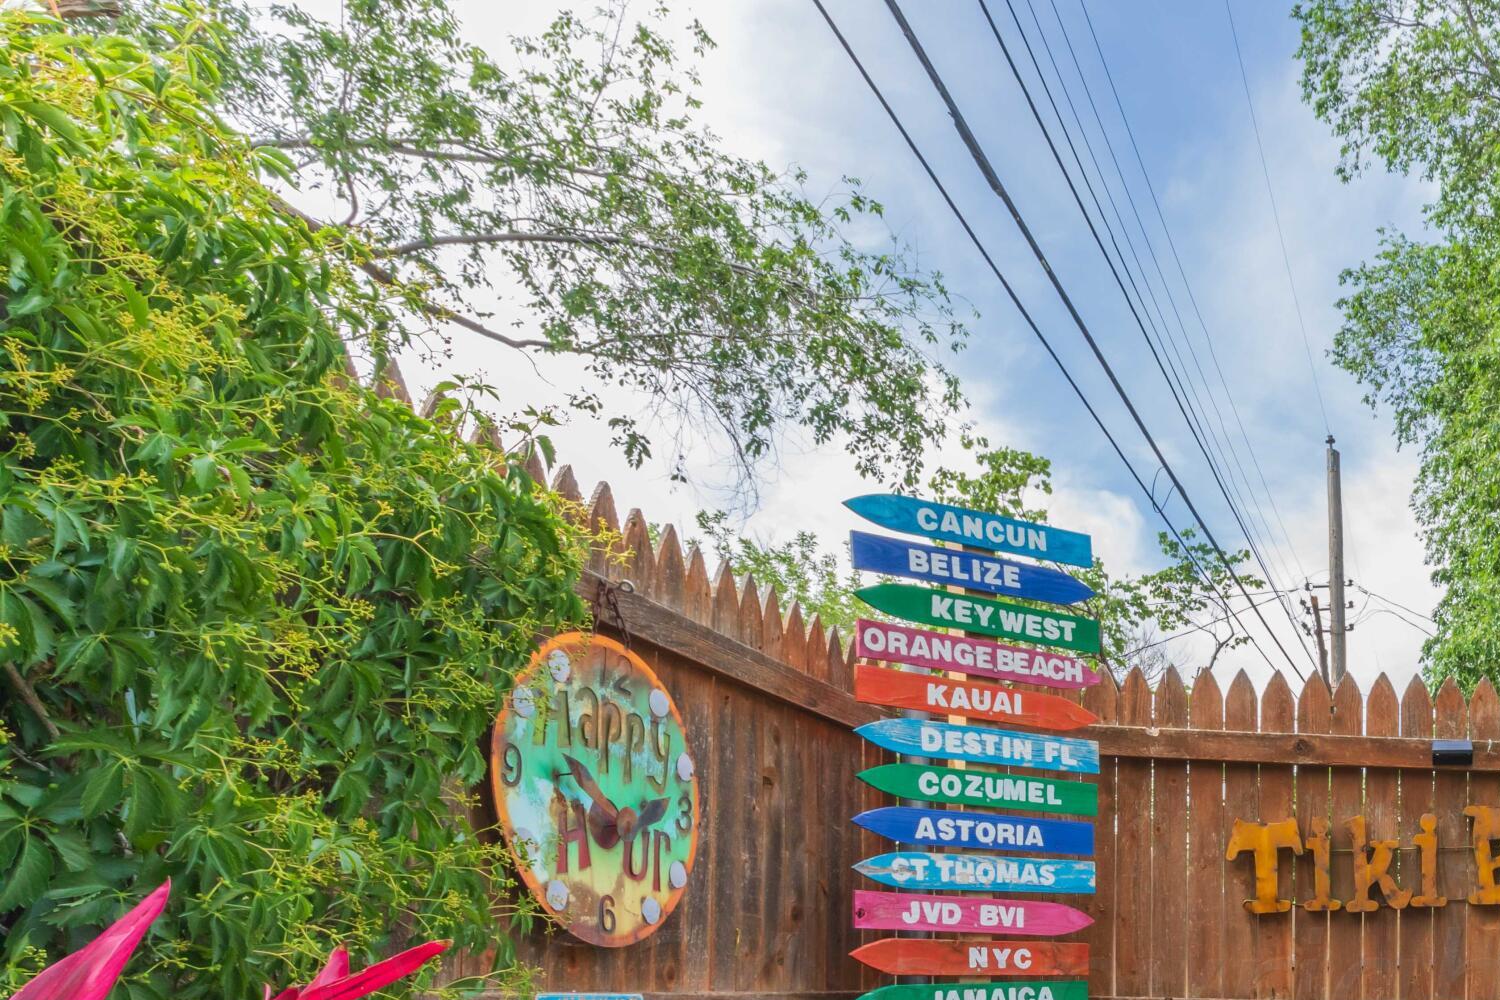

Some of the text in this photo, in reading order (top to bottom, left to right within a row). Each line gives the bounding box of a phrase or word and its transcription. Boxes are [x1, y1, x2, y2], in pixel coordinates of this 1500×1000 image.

[917, 507, 1047, 551] CANCUN
[908, 549, 1021, 588] BELIZE
[931, 595, 1076, 641] KEY WEST
[863, 627, 1083, 683] ORANGE BEACH
[927, 683, 1022, 715] KAUAI
[503, 742, 522, 787] 9
[920, 727, 1077, 766] DESTIN FL
[918, 771, 1062, 805] COZUMEL
[675, 796, 692, 833] 3
[915, 817, 1043, 847] ASTORIA
[891, 858, 1056, 886] ST THOMAS
[1225, 813, 1449, 914] Tiki
[600, 895, 616, 933] 6
[902, 901, 1025, 928] JVD BVI
[968, 947, 1032, 969] NYC
